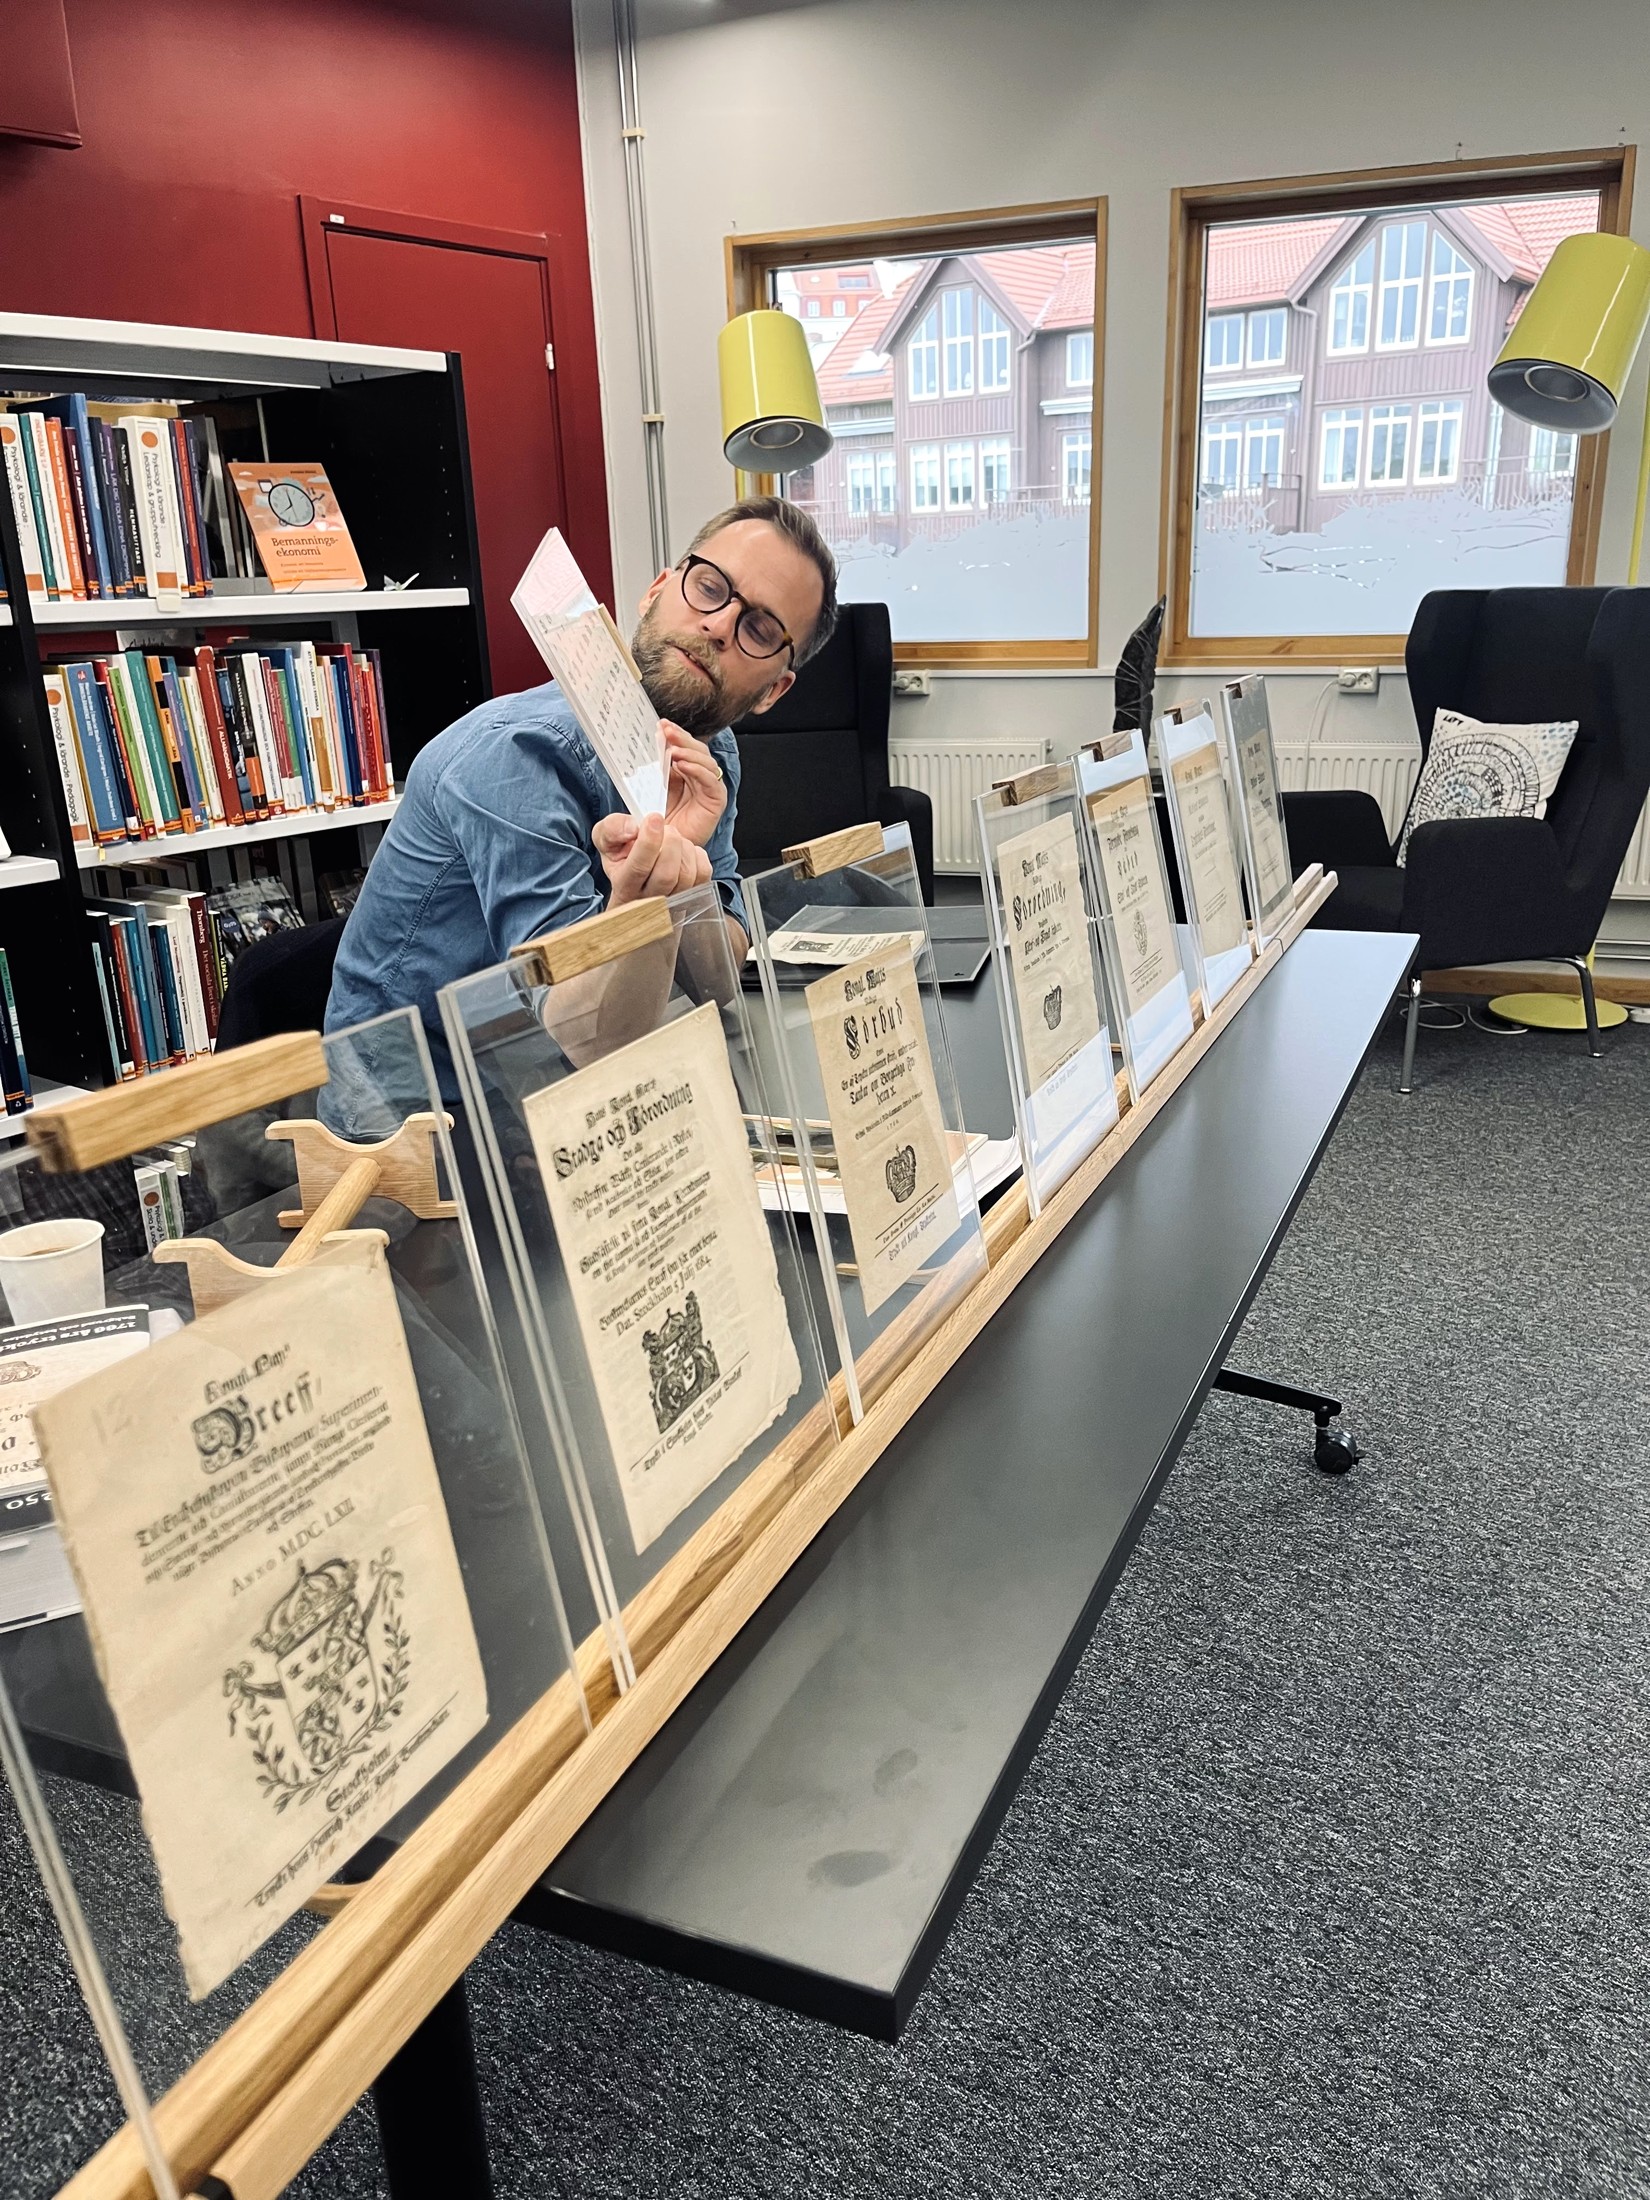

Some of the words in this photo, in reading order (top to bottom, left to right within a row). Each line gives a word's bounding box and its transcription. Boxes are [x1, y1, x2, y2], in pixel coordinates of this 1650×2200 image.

[11, 446, 21, 481] Psykologi
[18, 492, 28, 523] lärande
[152, 453, 161, 486] Psykologi
[157, 496, 165, 524] lärande
[143, 452, 152, 489] Ledarskap
[148, 499, 161, 558] grupputveckling
[271, 536, 339, 547] Bemannings-
[276, 546, 321, 557] ekonomi
[50, 707, 63, 741] Psykologi
[59, 749, 71, 778] lärande
[217, 730, 234, 779] ALLMÄNDIDAKTIK
[64, 783, 79, 823] Pedagogik
[196, 909, 205, 943] Thornberg
[553, 1137, 603, 1179] Stadga
[607, 1121, 626, 1148] och
[626, 1084, 692, 1135] Förordning
[155, 1206, 164, 1232] Psykologi
[633, 1285, 673, 1321] Stockholm
